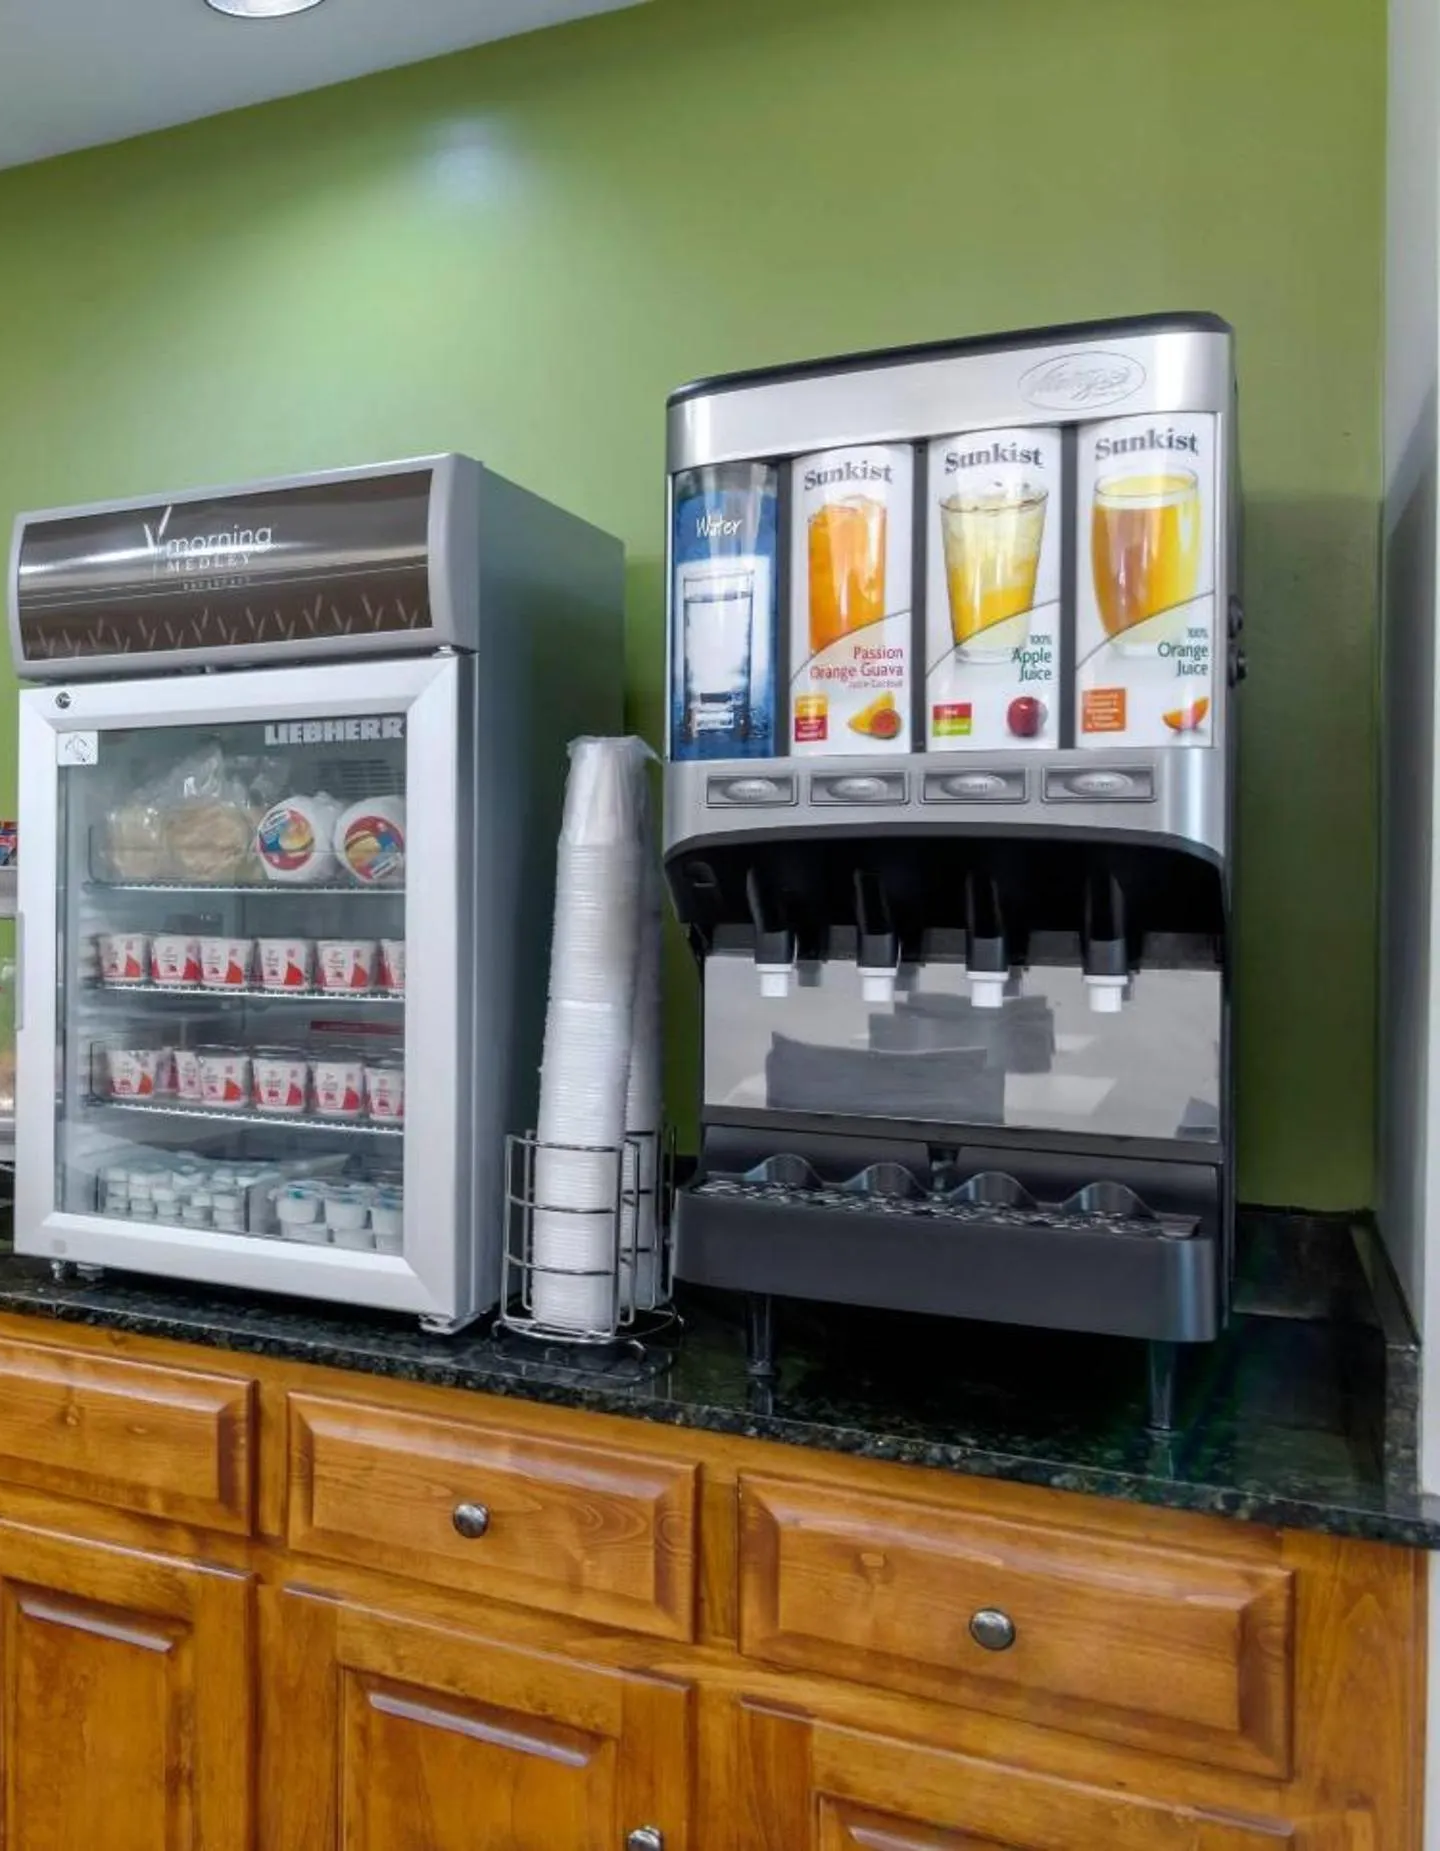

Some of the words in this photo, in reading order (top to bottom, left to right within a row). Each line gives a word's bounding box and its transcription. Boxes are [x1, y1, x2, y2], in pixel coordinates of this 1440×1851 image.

[1094, 427, 1200, 461] Sunkist
[944, 442, 1045, 475] Sunkist
[803, 461, 893, 492] Sunkist
[696, 515, 743, 538] Water
[166, 523, 273, 559] morning
[166, 552, 251, 573] MEDLEY
[853, 646, 904, 660] Passion
[1011, 647, 1052, 668] Apple
[1157, 641, 1209, 661] Orange
[810, 665, 857, 684] Orange
[861, 662, 904, 676] Guava
[1018, 664, 1052, 682] Juice
[1176, 660, 1209, 677] Juice
[264, 717, 405, 746] LIEBHERR
